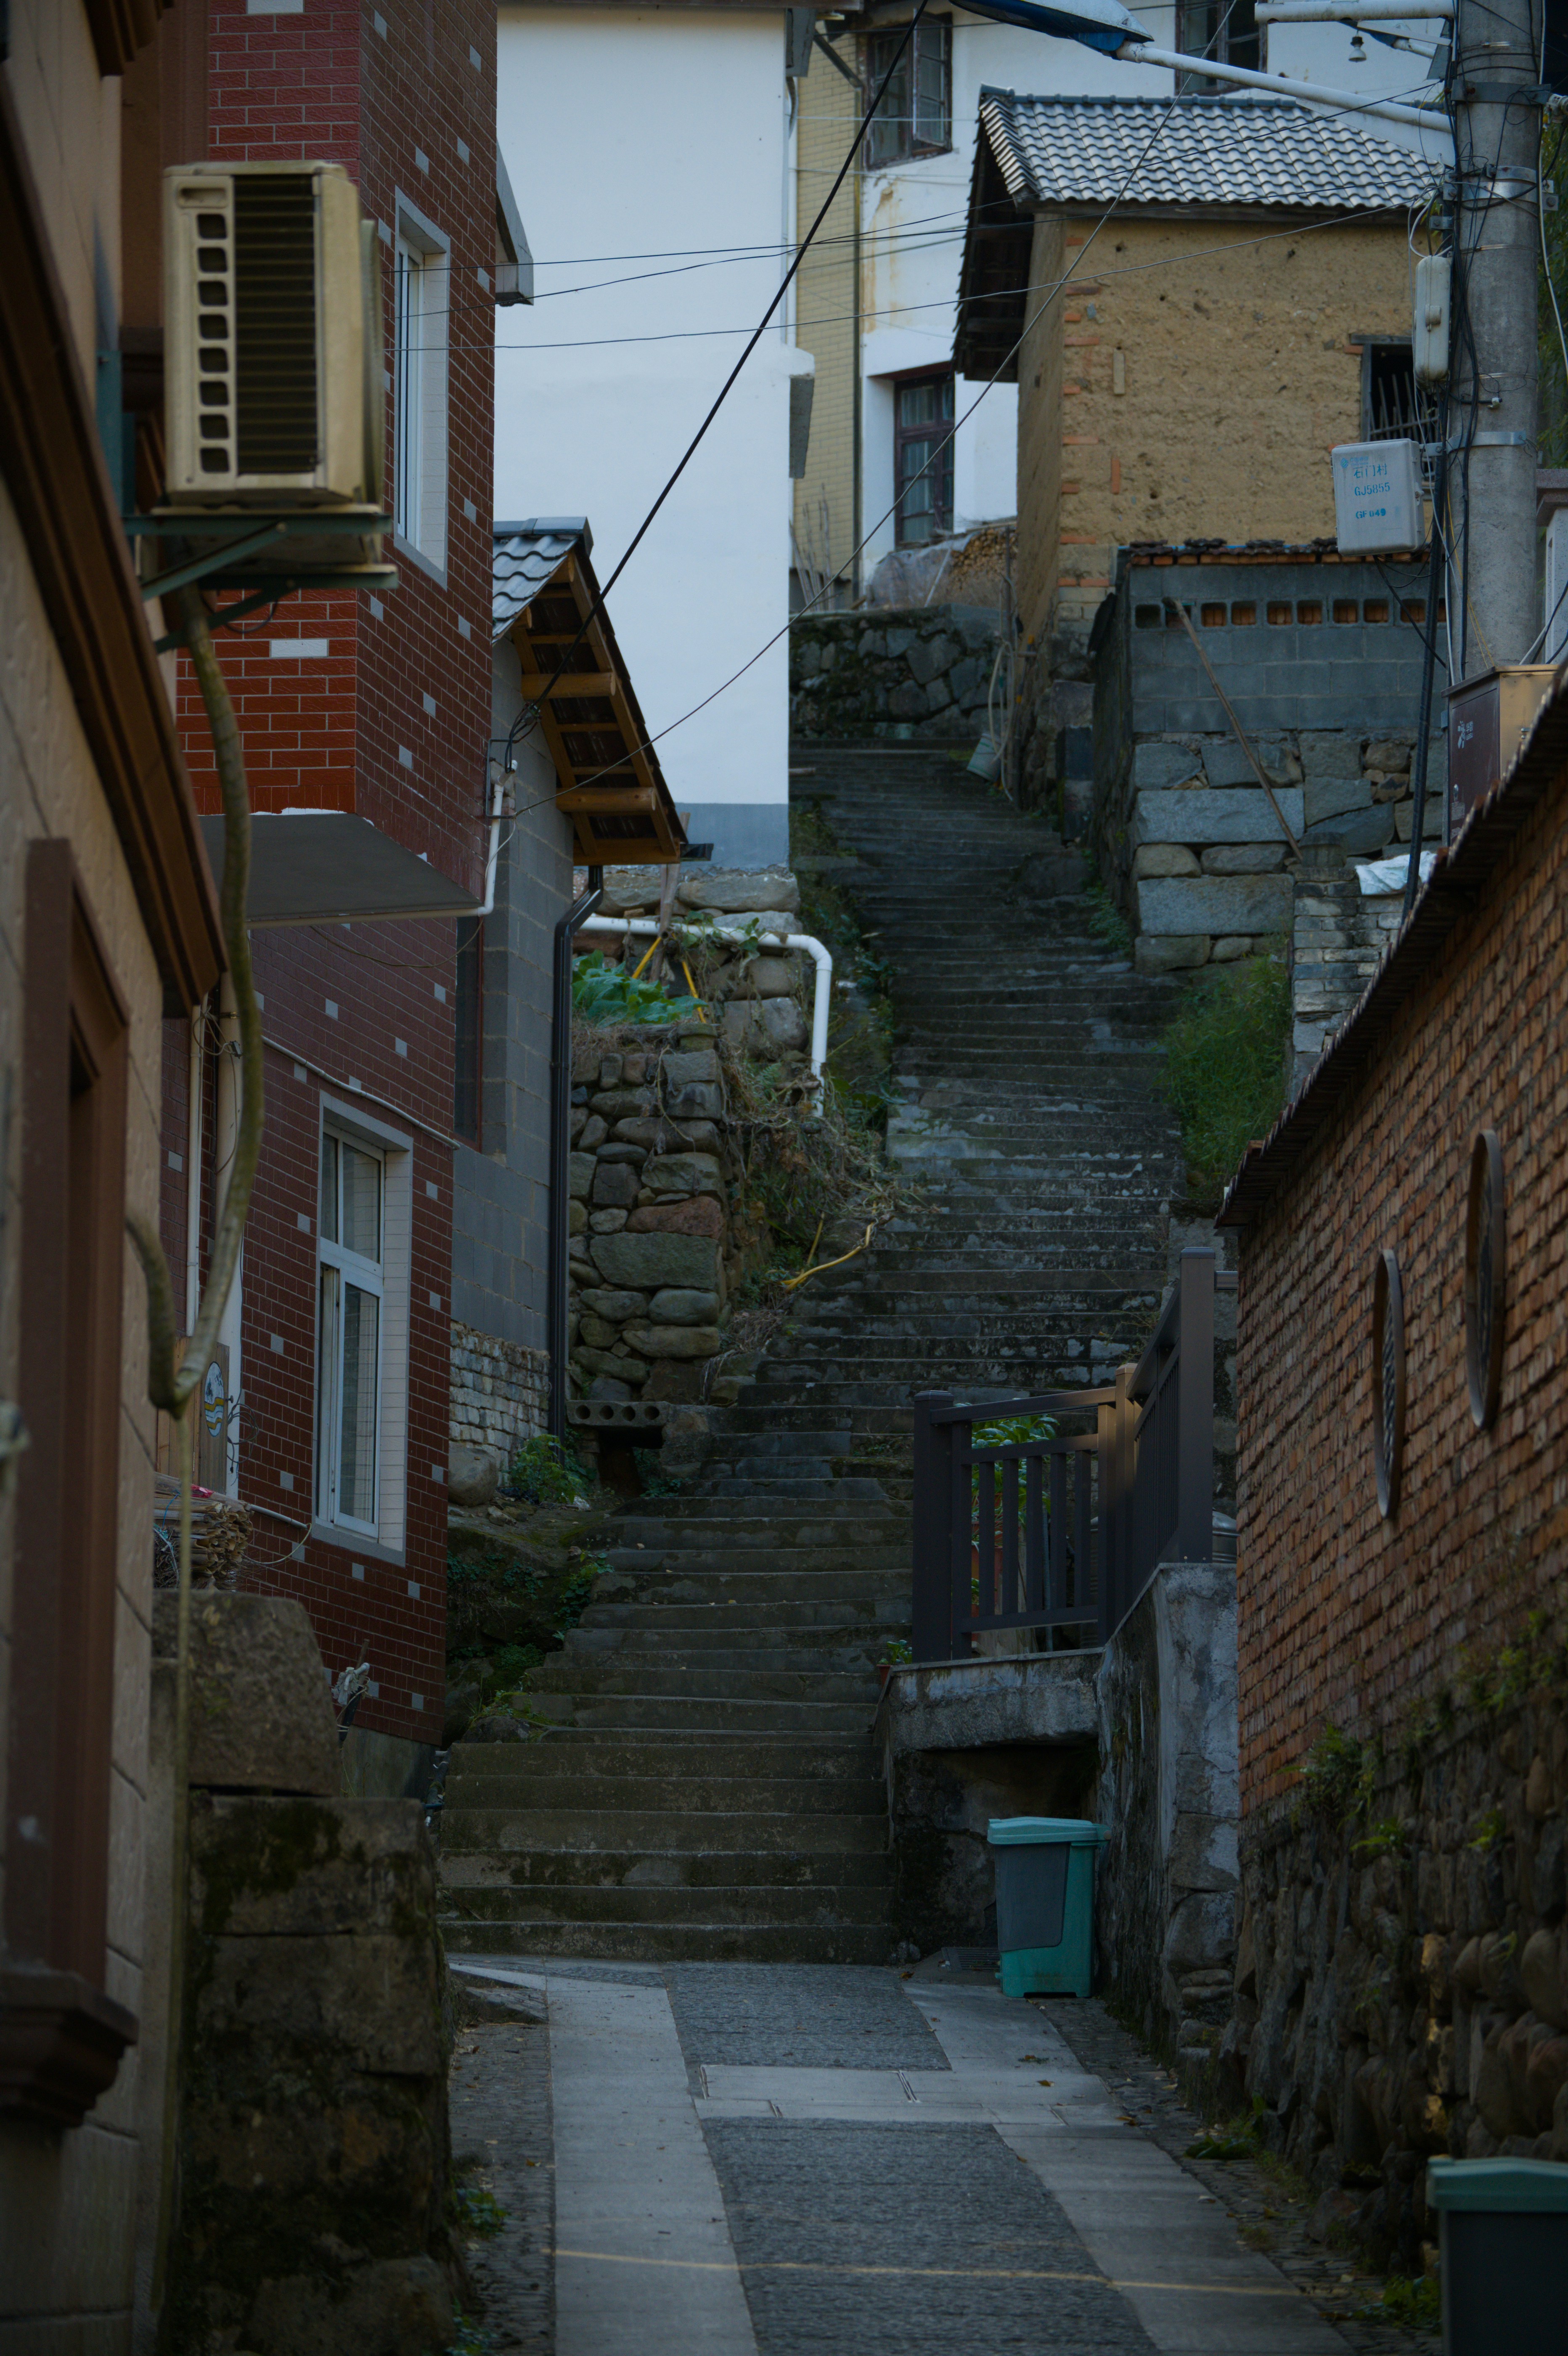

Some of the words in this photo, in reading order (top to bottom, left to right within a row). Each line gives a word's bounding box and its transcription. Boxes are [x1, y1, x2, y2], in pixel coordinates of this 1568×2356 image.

[1353, 463, 1387, 478] 石门村
[1354, 482, 1390, 496] GJ5855
